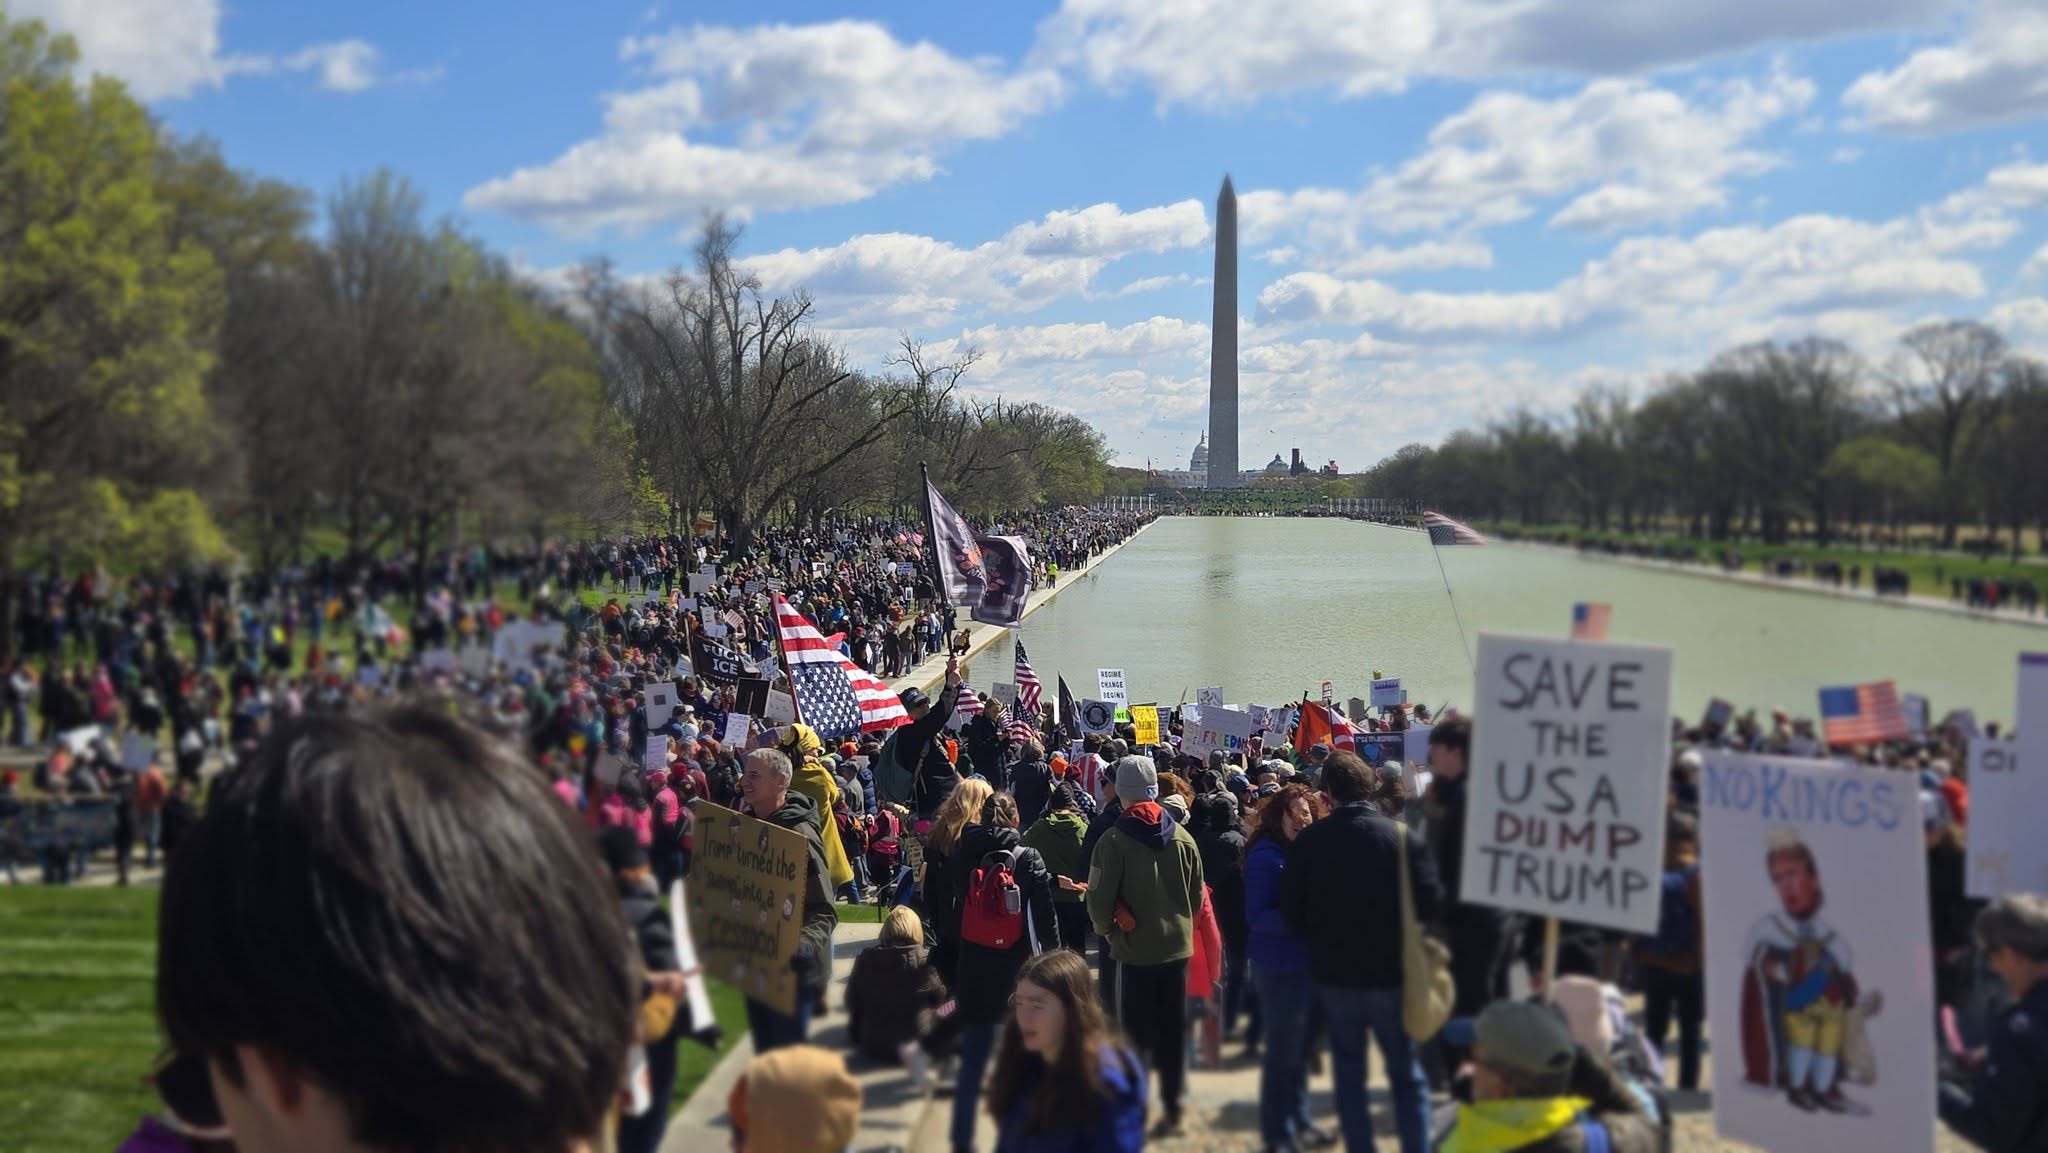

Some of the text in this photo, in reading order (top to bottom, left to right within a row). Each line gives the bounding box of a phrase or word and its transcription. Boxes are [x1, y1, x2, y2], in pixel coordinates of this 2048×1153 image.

[713, 659, 738, 675] ICE
[1101, 681, 1123, 689] CHANGE
[1498, 652, 1644, 711] SAVE
[1529, 719, 1609, 758] THE
[1496, 760, 1620, 818] USA
[1493, 810, 1642, 861] DUMP
[737, 845, 773, 875] turned
[776, 848, 796, 881] the
[1479, 844, 1649, 911] TRUMP
[766, 889, 775, 908] a
